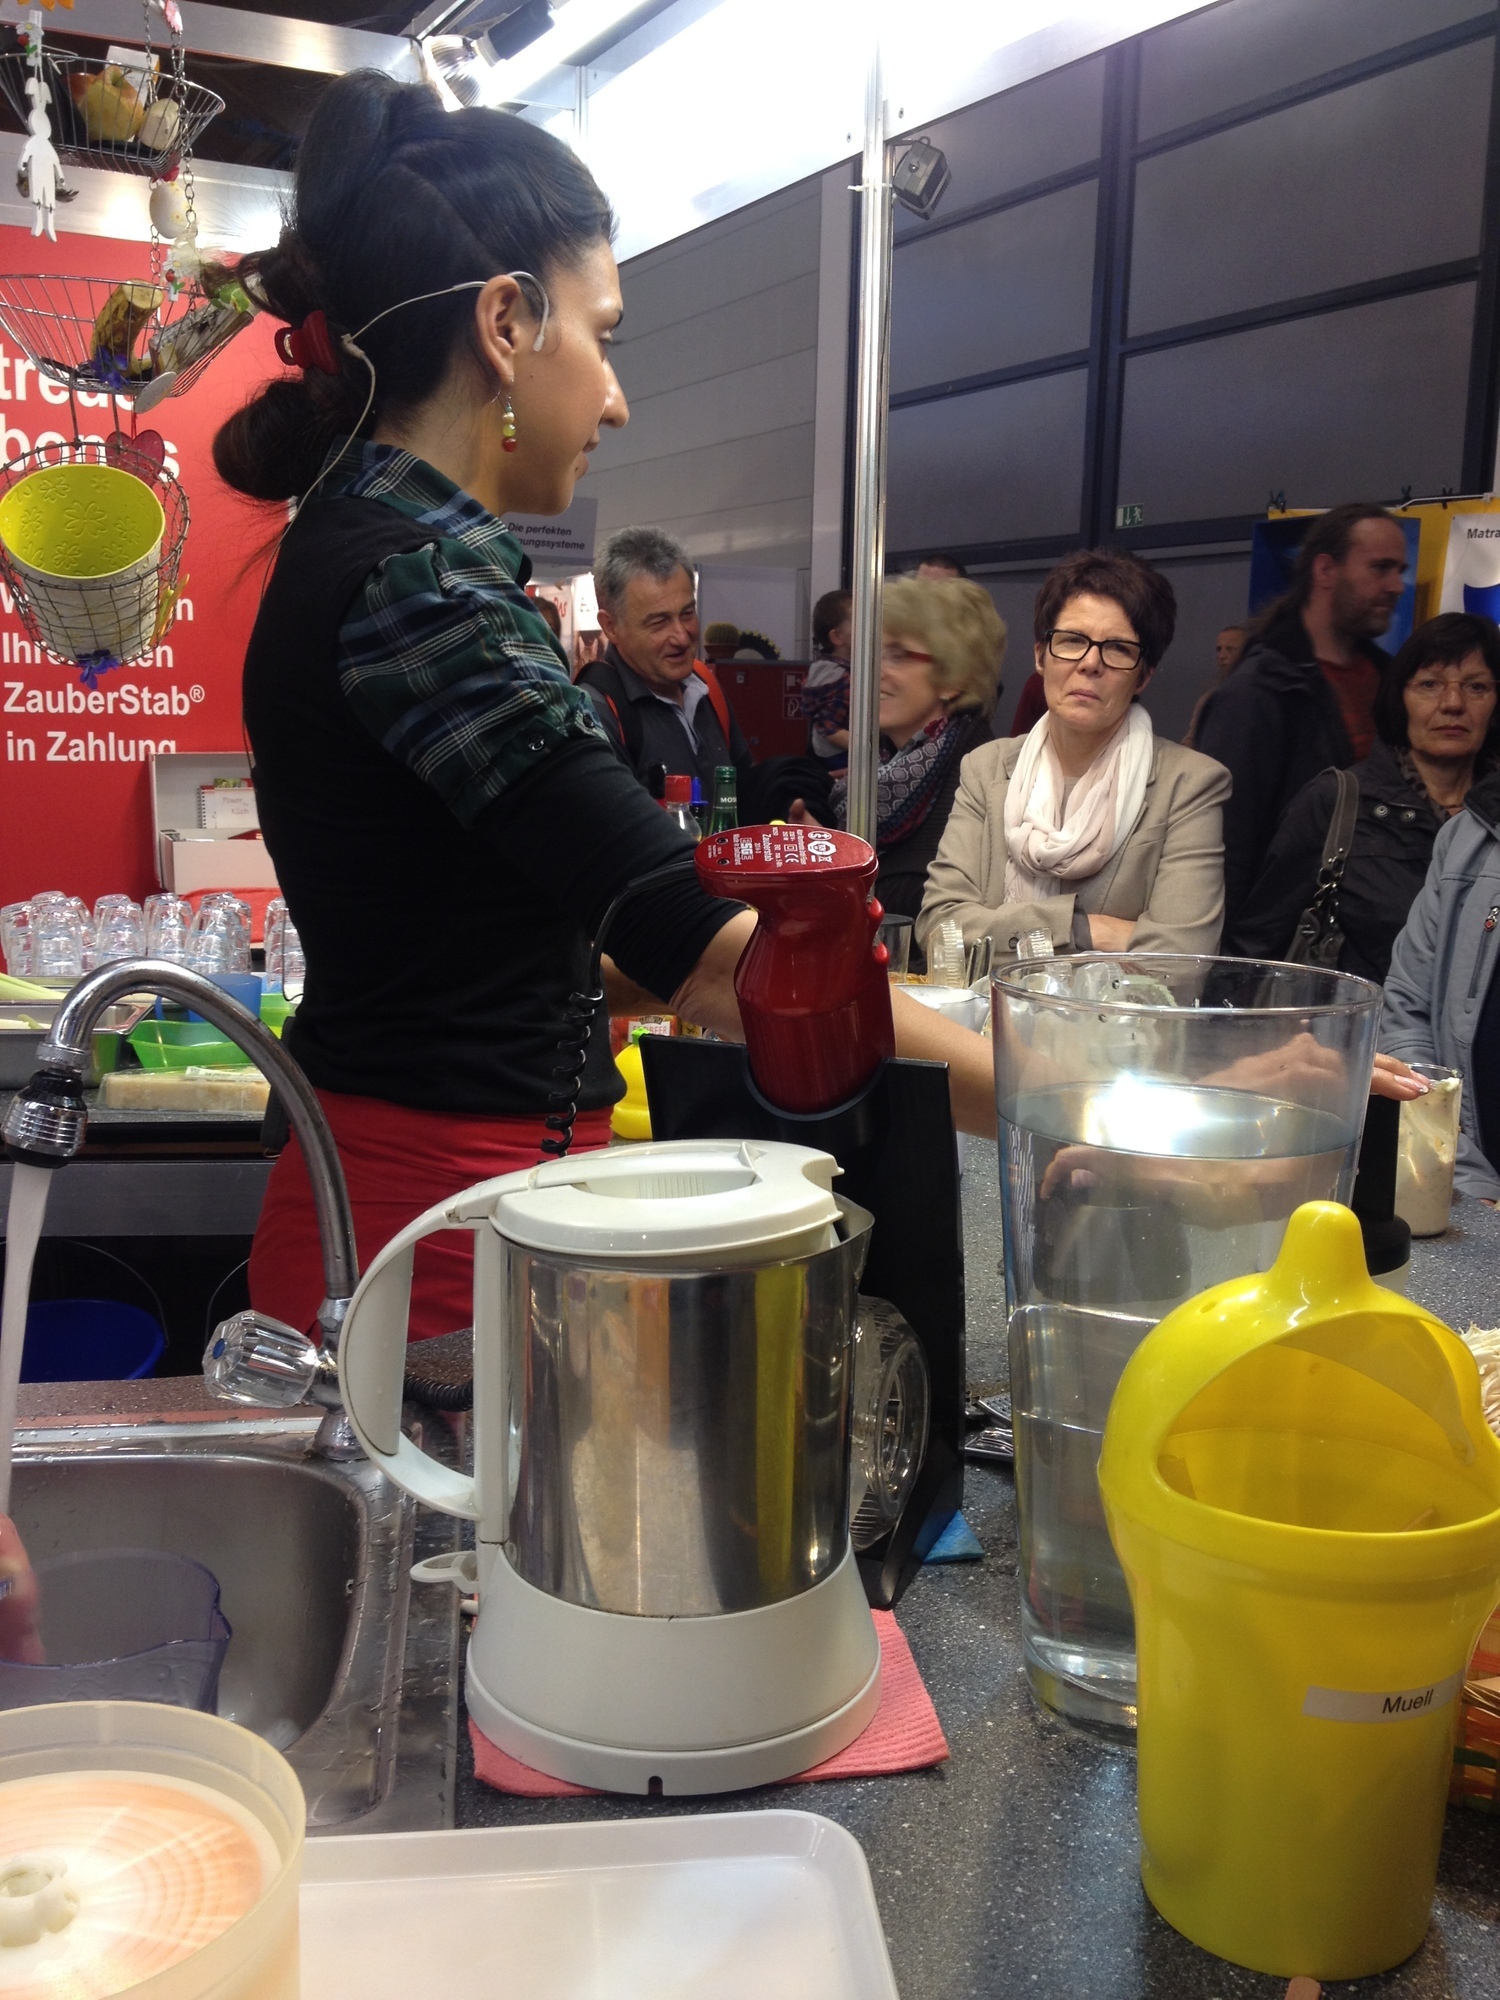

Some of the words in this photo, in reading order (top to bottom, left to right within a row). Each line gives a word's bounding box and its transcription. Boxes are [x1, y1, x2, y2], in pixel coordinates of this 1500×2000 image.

[508, 522, 524, 533] Die
[526, 525, 572, 536] perfekten
[3, 681, 205, 716] ZauberStab®
[6, 731, 36, 762] in
[1382, 1688, 1434, 1714] Muell
